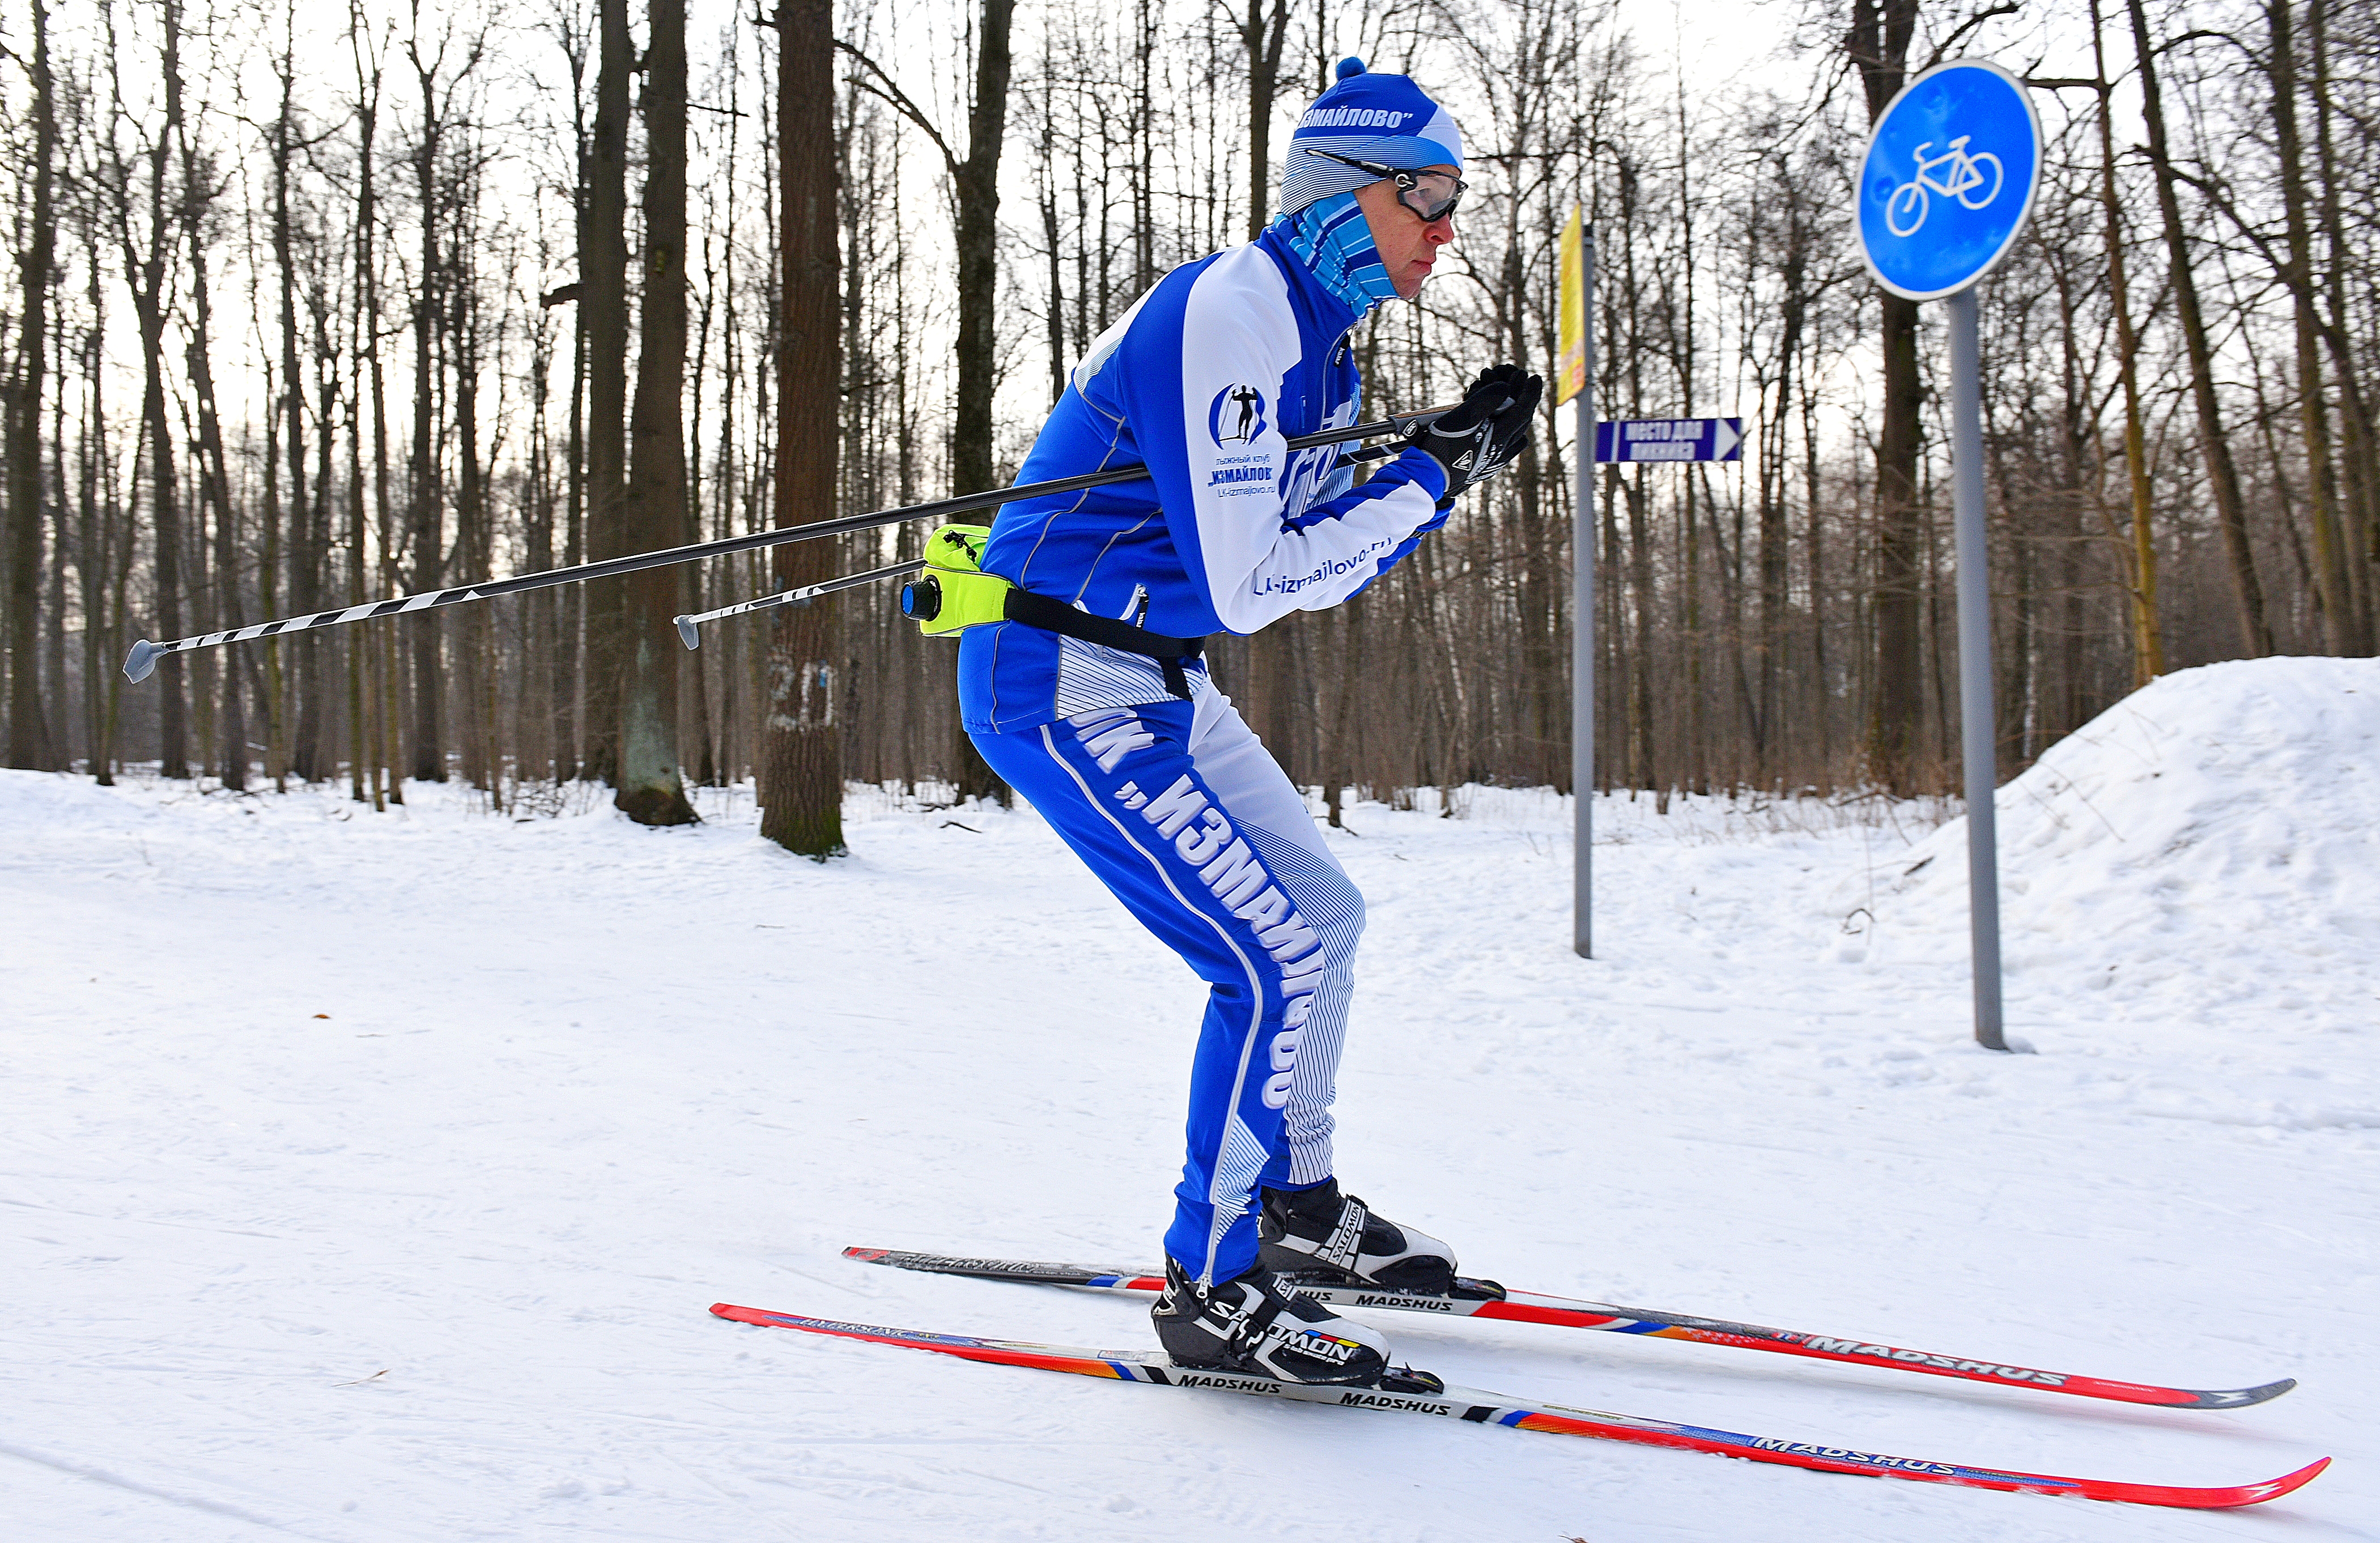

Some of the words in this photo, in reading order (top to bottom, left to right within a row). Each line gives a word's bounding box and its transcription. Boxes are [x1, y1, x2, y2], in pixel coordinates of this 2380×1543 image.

[1332, 1203, 1361, 1262] SALOMON
[1355, 1294, 1453, 1311] MADSHUS
[1803, 1335, 2069, 1387] MADSHUS
[1178, 1374, 1282, 1395] MADSHUS
[1340, 1392, 1451, 1416] MADSHUS
[1753, 1436, 1958, 1476] MADSHUS
